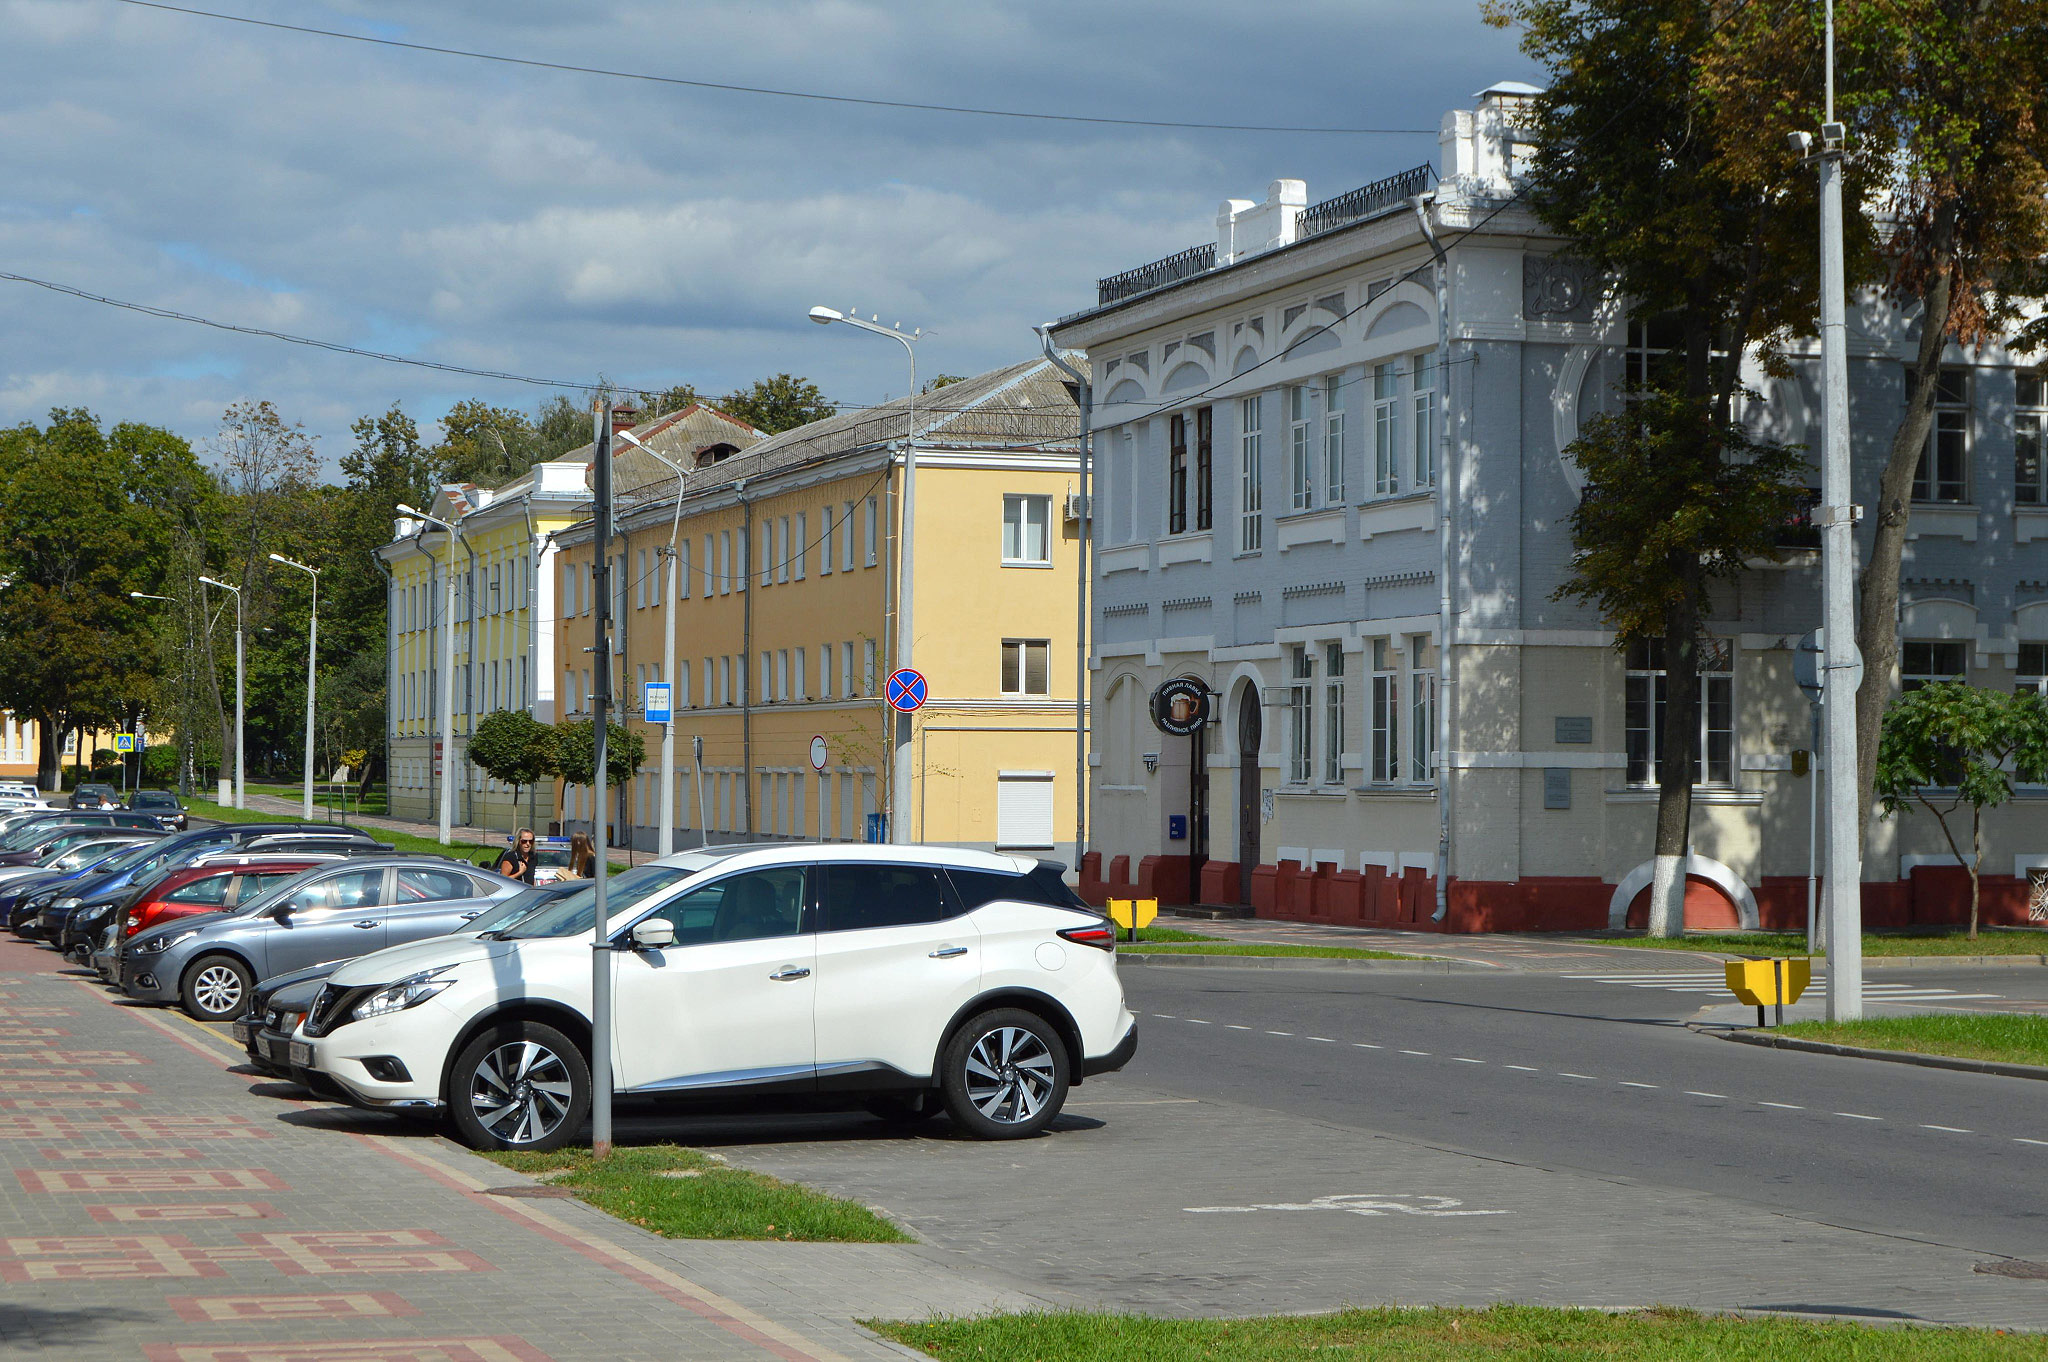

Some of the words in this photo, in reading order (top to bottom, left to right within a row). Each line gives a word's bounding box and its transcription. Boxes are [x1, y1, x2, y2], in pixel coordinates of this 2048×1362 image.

[1162, 682, 1184, 696] ПИВНАЯ
[1184, 683, 1202, 696] ЛАВКА
[1161, 717, 1189, 733] РАЗЛИВНОЕ
[1190, 717, 1203, 730] ПИВО
